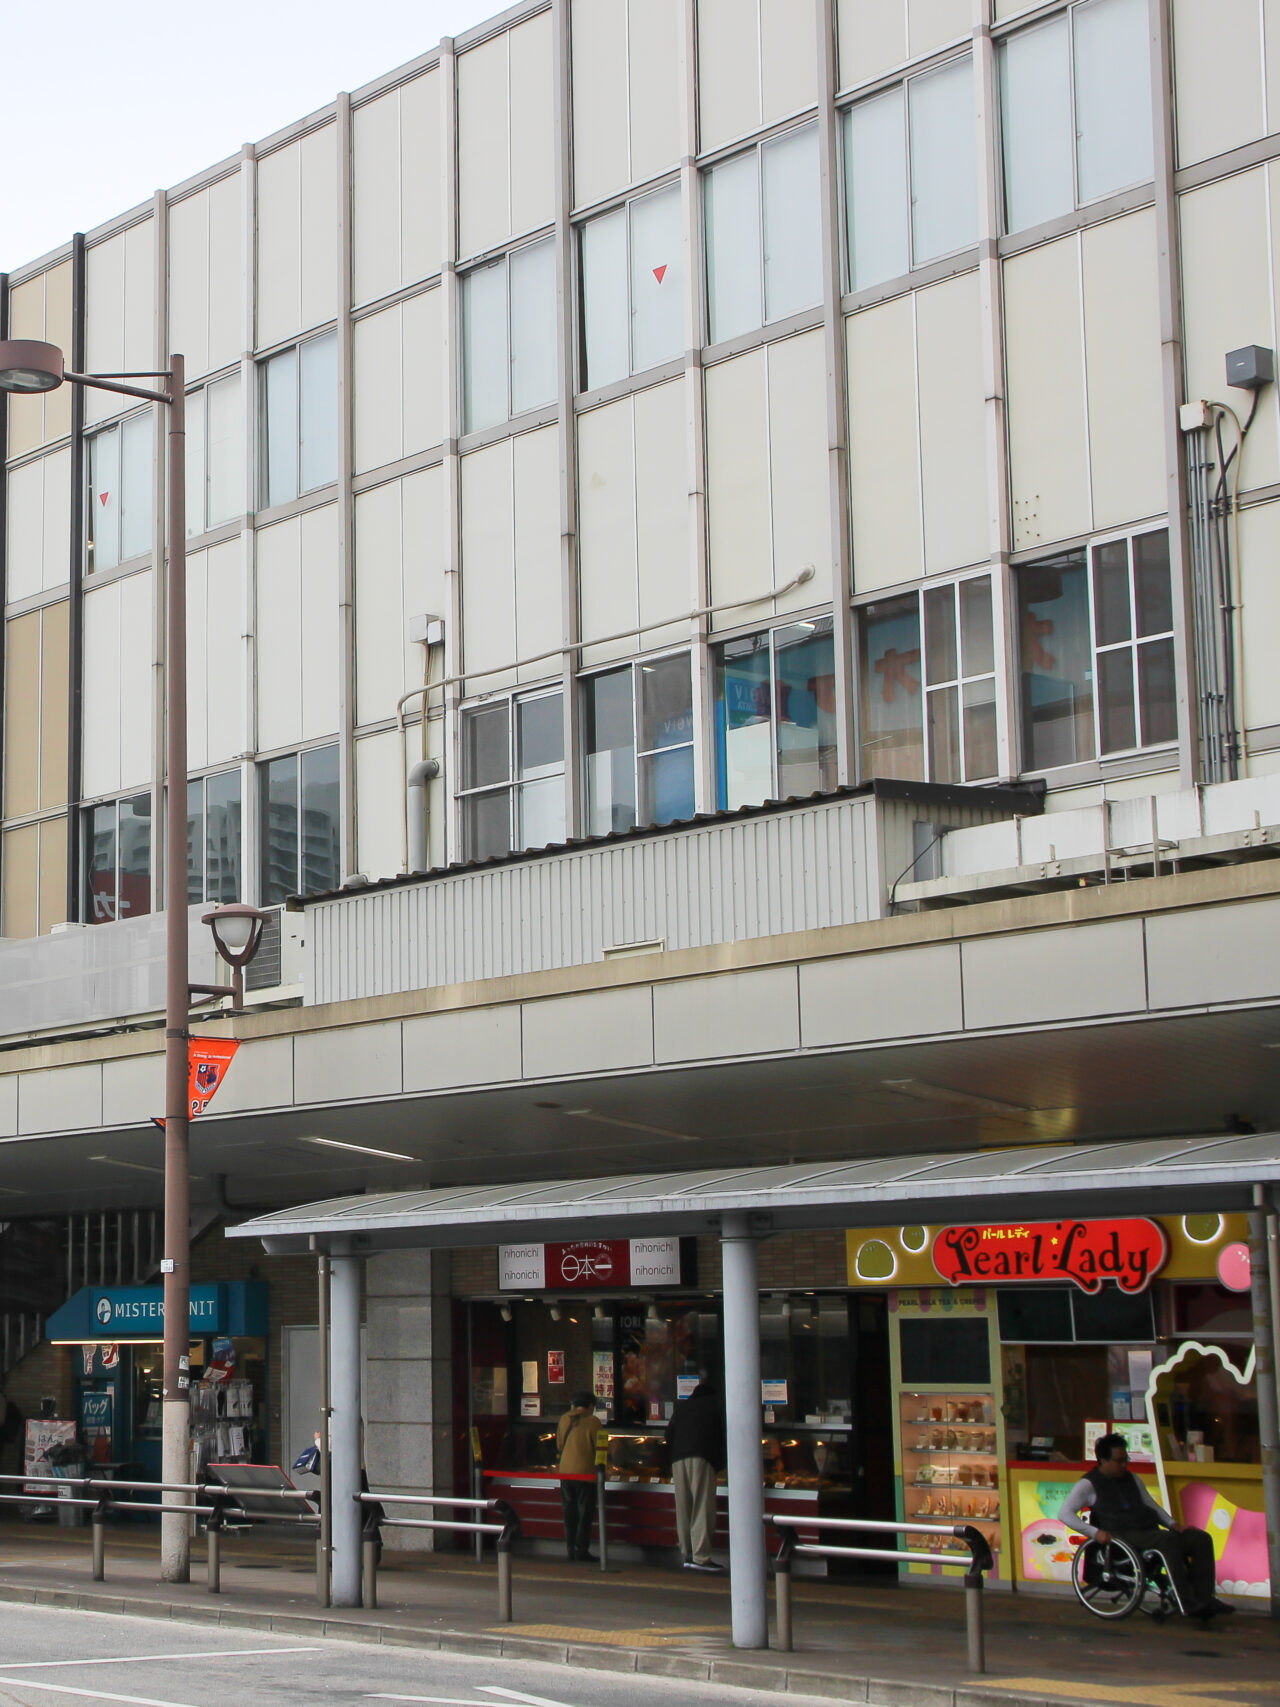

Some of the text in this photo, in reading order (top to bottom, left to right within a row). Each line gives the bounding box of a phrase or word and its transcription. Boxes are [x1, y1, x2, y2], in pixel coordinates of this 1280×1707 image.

[504, 1247, 539, 1259] nihonichi
[635, 1241, 674, 1253] nihonichi
[945, 1223, 1151, 1290] Pearl Lady
[504, 1268, 540, 1281] nihonichi
[561, 1254, 613, 1282] 日本一
[635, 1264, 674, 1276] nihonichi
[115, 1300, 215, 1317] MISTER NIT
[83, 1397, 108, 1415] バッグ
